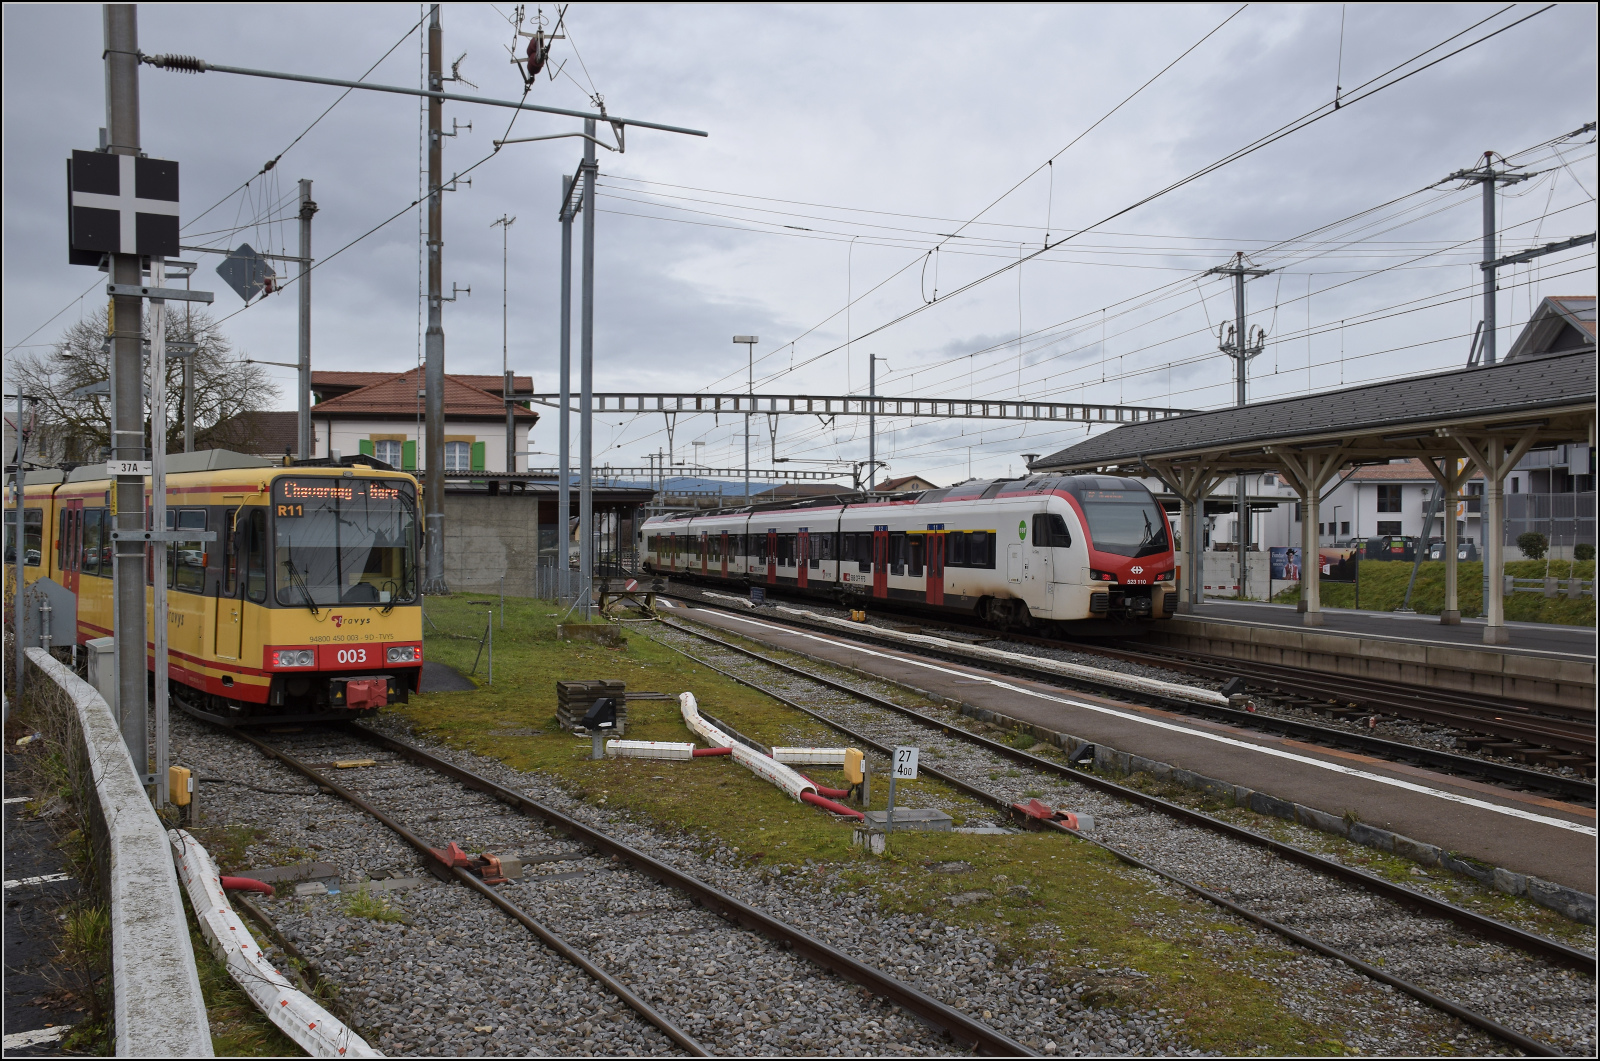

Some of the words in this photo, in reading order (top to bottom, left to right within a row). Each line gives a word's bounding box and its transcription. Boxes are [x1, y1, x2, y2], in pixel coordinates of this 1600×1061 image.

[121, 463, 138, 472] 37A
[277, 505, 302, 516] R11
[337, 648, 367, 663] 003
[898, 750, 911, 762] 27
[897, 763, 912, 776] 400
